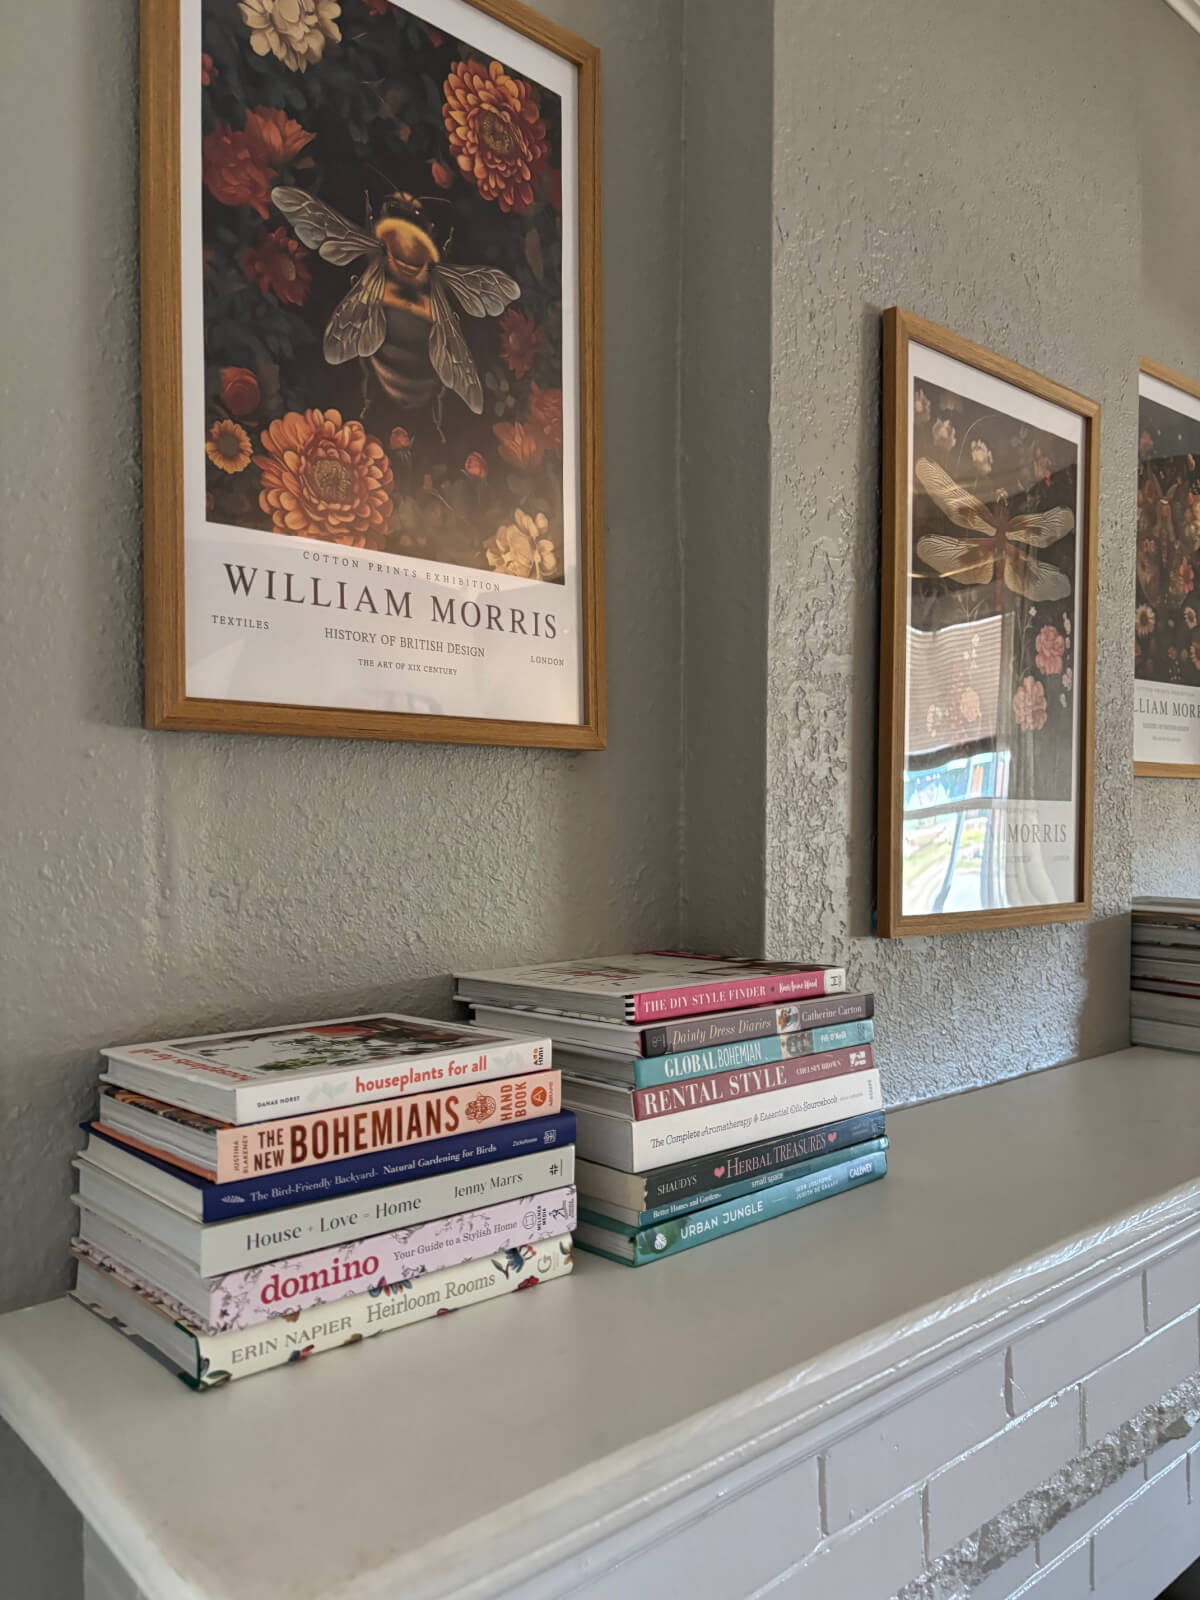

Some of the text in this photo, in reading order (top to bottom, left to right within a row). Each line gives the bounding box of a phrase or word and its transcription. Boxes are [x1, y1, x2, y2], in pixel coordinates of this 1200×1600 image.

[302, 551, 501, 592] COTTON PRINTS EXHIBITION
[223, 562, 558, 640] WILLIAM MORRIS
[212, 614, 271, 631] TEXTILES
[325, 627, 486, 658] HISTORY OF BRITISH DESIGN
[530, 655, 565, 667] LONDON
[358, 658, 458, 677] THE ART OF XIX CENTURY
[1008, 824, 1067, 843] MORRIS
[643, 999, 667, 1013] THE
[670, 995, 689, 1009] DIY
[692, 991, 726, 1006] STYLE
[729, 986, 766, 1001] FINDER
[672, 1030, 706, 1046] Dainty
[709, 1024, 736, 1039] Dress
[738, 1019, 771, 1034] Diaries
[801, 1008, 836, 1022] Catherine
[838, 1004, 862, 1016] Carton
[355, 1067, 444, 1093] houseplants
[448, 1060, 468, 1081] for
[472, 1055, 487, 1073] all
[664, 1051, 717, 1078] GLOBAL
[717, 1042, 762, 1068] BOHEMIAN
[500, 1084, 513, 1121] HAND
[514, 1081, 527, 1118] BOOK
[643, 1079, 724, 1115] RENTAL
[729, 1065, 787, 1096] STYLE
[258, 1095, 459, 1165] THE BOHEMIANS
[651, 1138, 665, 1149] The
[665, 1131, 700, 1146] Complete
[701, 1116, 752, 1137] Aromatherapy
[760, 1106, 789, 1122] Essential
[789, 1103, 802, 1114] Oils
[803, 1096, 838, 1112] Sourcebook
[250, 1191, 268, 1202] The
[271, 1178, 332, 1199] Bird-Friendly
[383, 1160, 416, 1175] Natural
[418, 1152, 460, 1167] Gardening
[462, 1149, 473, 1159] for
[476, 1144, 497, 1155] Birds
[253, 1149, 285, 1172] NEW
[657, 1132, 827, 1196] SHAUDYS HERBAL TREASURES
[849, 1162, 873, 1178] CALLWEY
[247, 1226, 302, 1250] House
[320, 1212, 358, 1233] Love
[376, 1197, 422, 1219] Home
[454, 1181, 487, 1198] Jenny
[490, 1172, 523, 1190] Marrs
[653, 1207, 670, 1219] Better
[670, 1202, 689, 1214] Homes
[690, 1197, 699, 1208] and
[751, 1176, 767, 1188] small
[768, 1171, 784, 1183] space
[681, 1201, 764, 1239] URBAN JUNGLE
[261, 1255, 380, 1304] domino
[394, 1248, 417, 1261] Your
[417, 1241, 444, 1255] Guide
[445, 1238, 454, 1247] to
[462, 1227, 492, 1243] Stylish
[493, 1221, 518, 1234] Home
[231, 1339, 278, 1364] ERIN
[285, 1316, 352, 1348] NAPIER
[367, 1289, 441, 1323] Heirloom
[445, 1275, 496, 1300] Rooms
